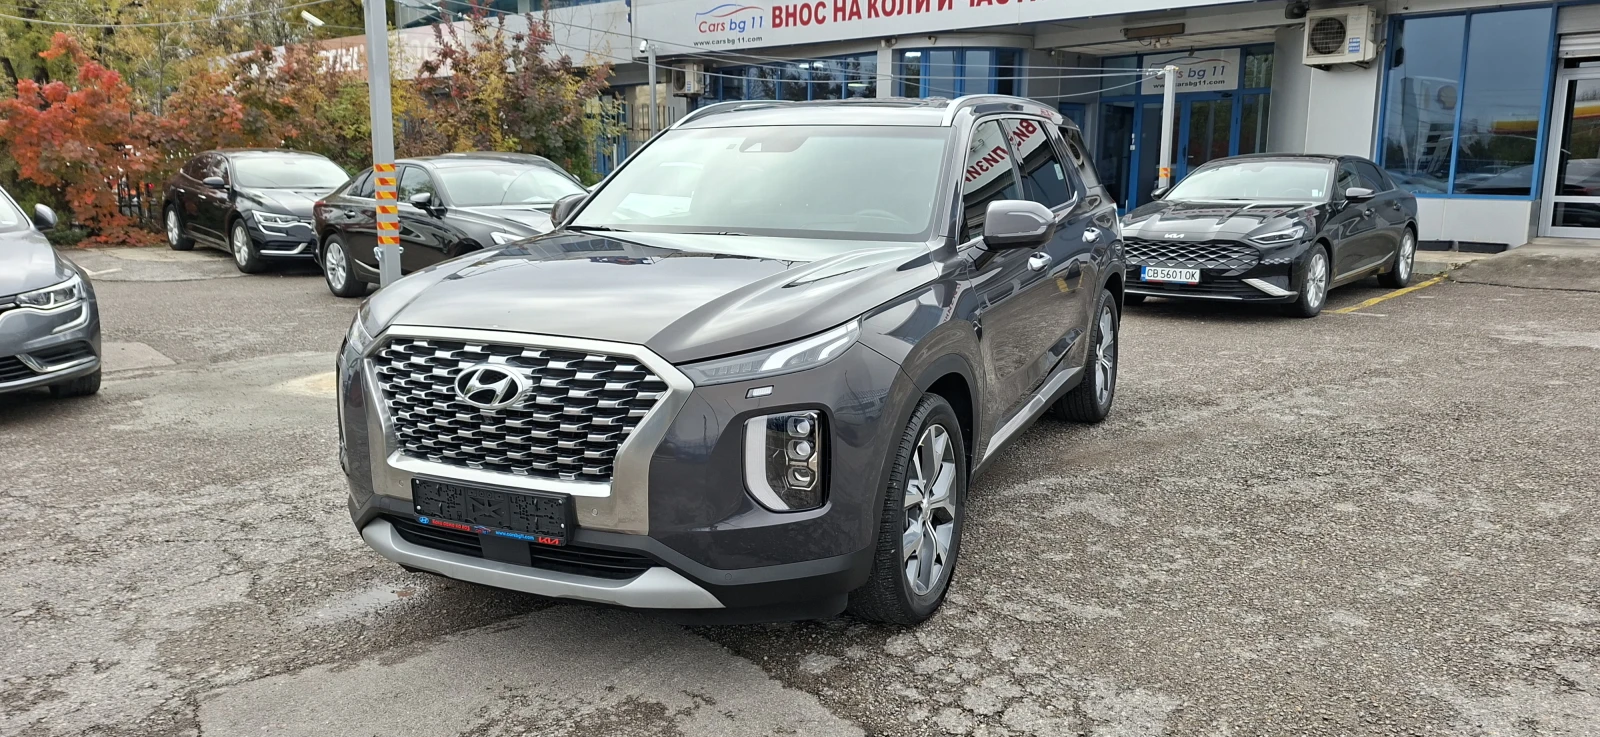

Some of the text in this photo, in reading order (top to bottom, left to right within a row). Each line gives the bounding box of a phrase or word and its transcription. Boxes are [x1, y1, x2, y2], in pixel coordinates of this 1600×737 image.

[771, 1, 827, 28] ВНОС
[833, 0, 862, 22] НА
[698, 16, 763, 33] Cars bg 11
[1187, 68, 1206, 80] bg
[1212, 65, 1226, 76] 11
[1147, 268, 1198, 281] CB 5601 OK
[538, 536, 559, 545] KIA
